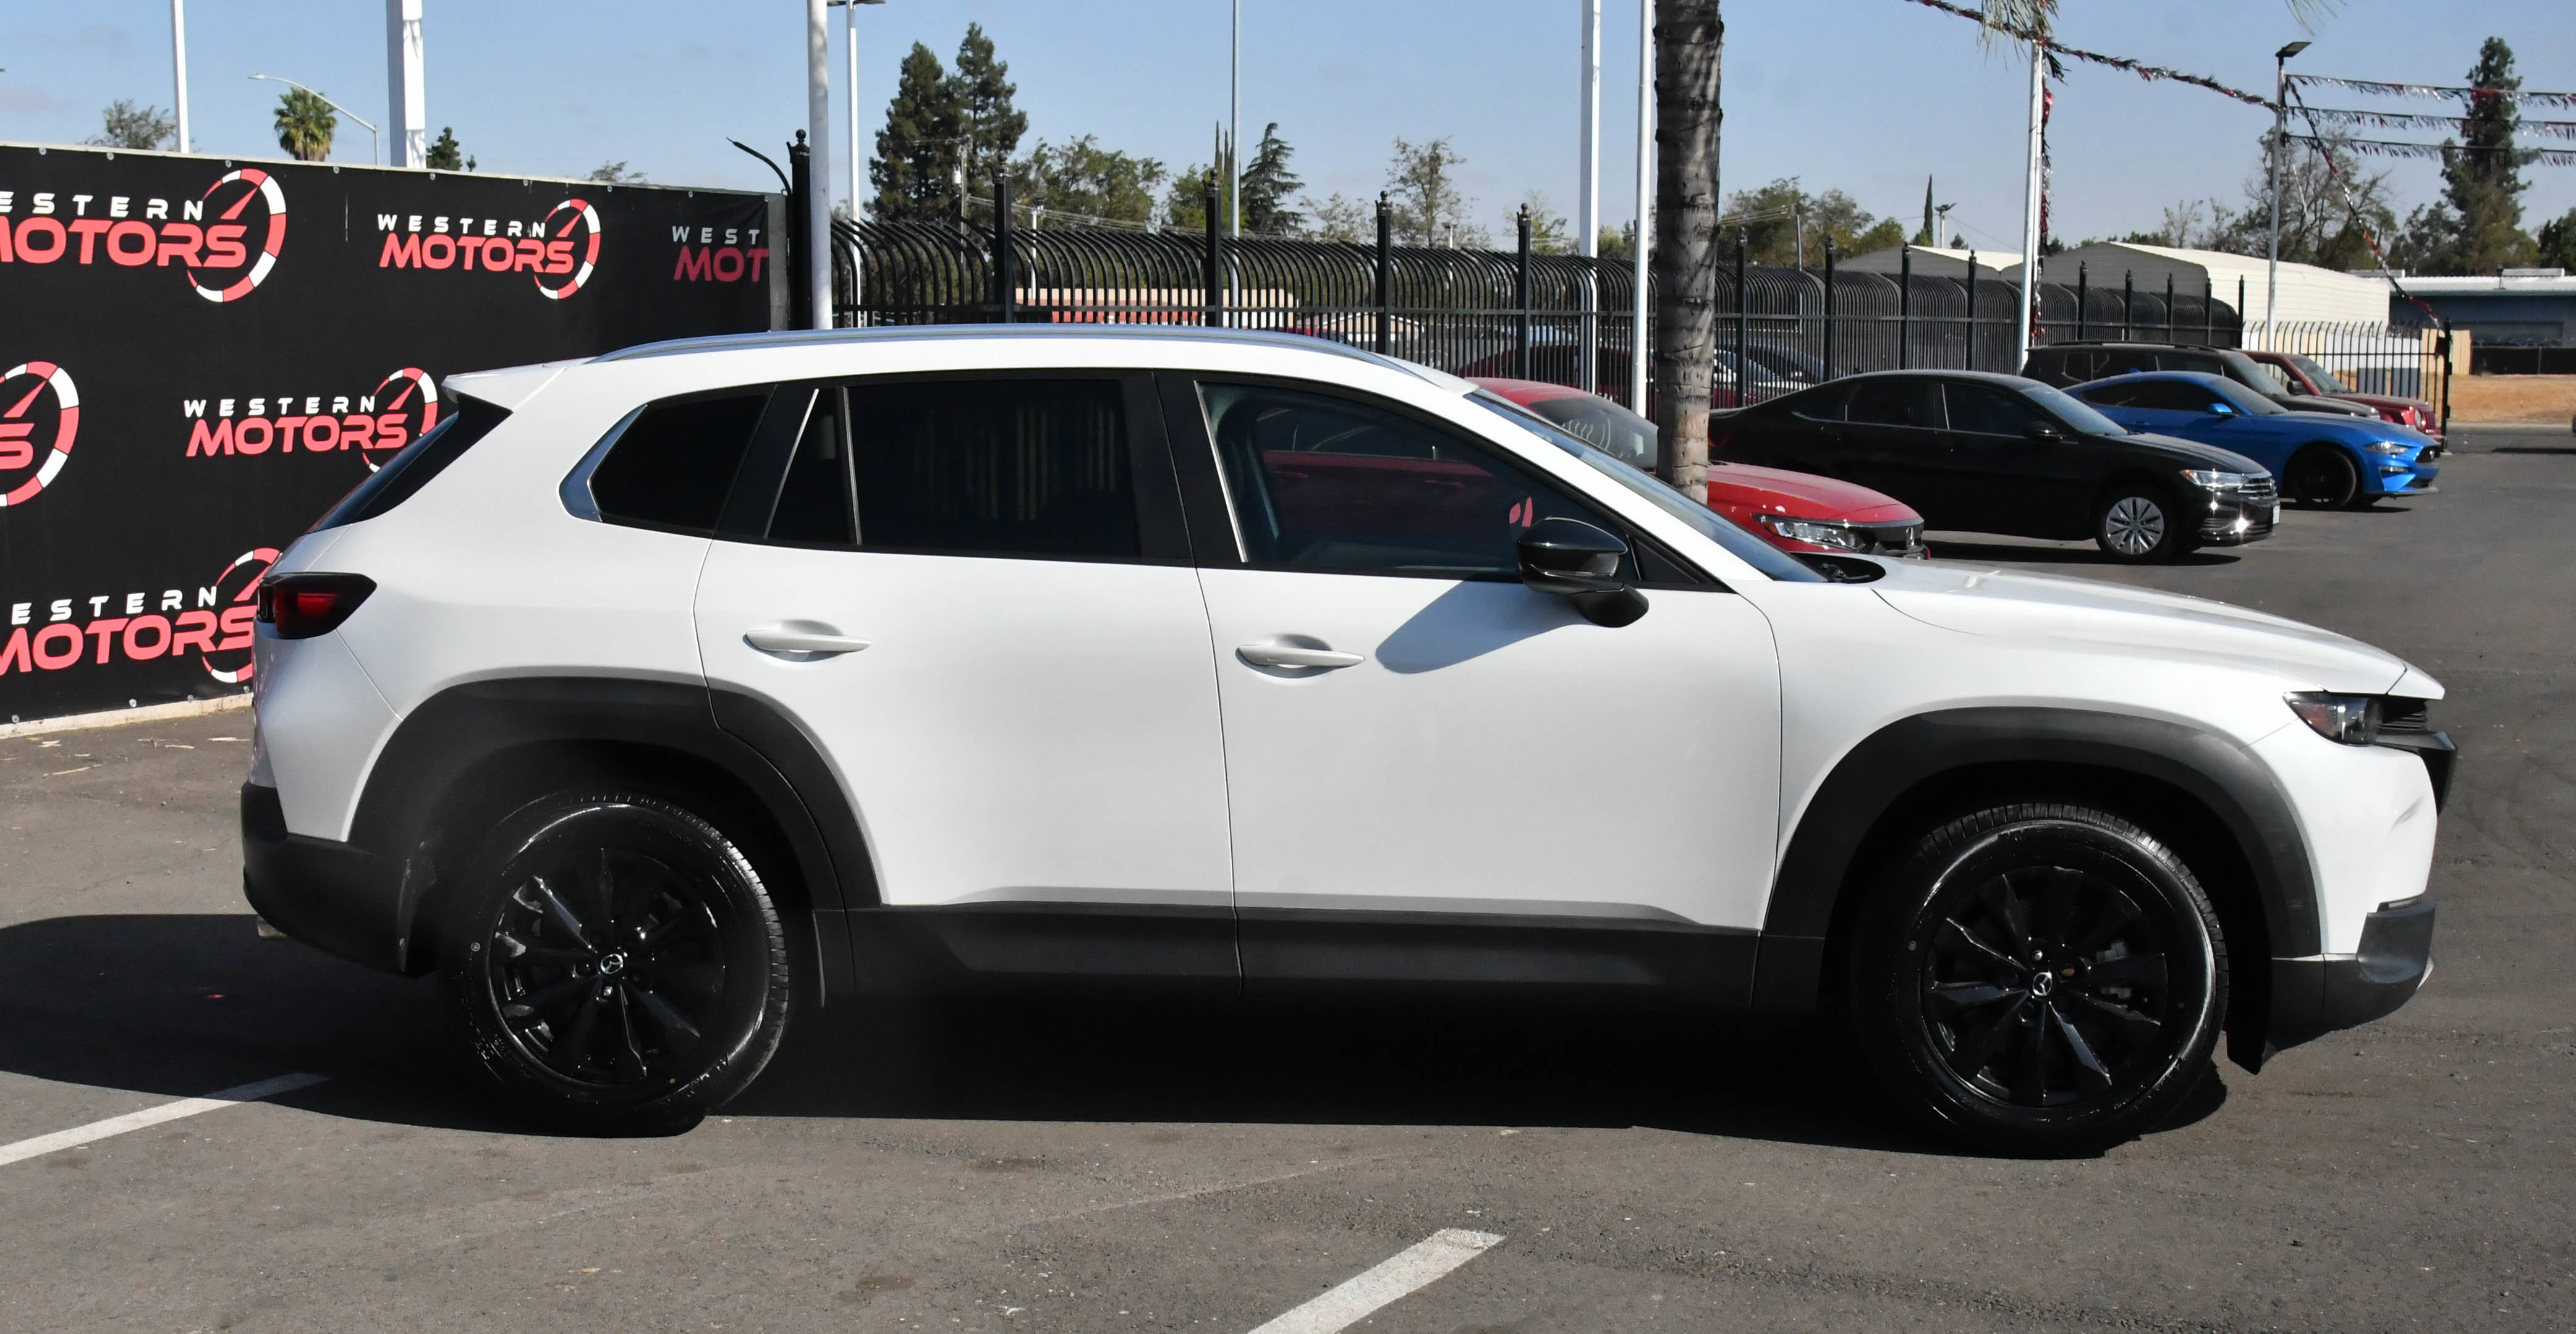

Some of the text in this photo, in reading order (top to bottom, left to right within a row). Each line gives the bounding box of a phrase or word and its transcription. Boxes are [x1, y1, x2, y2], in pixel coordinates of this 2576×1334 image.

[0, 215, 248, 269] OTORS
[377, 213, 546, 239] WESTERN
[672, 226, 760, 245] WEST
[379, 232, 575, 274] MOTORS
[674, 245, 769, 282] MOT
[184, 396, 375, 418] WESTERN
[185, 413, 409, 457] MOTORS
